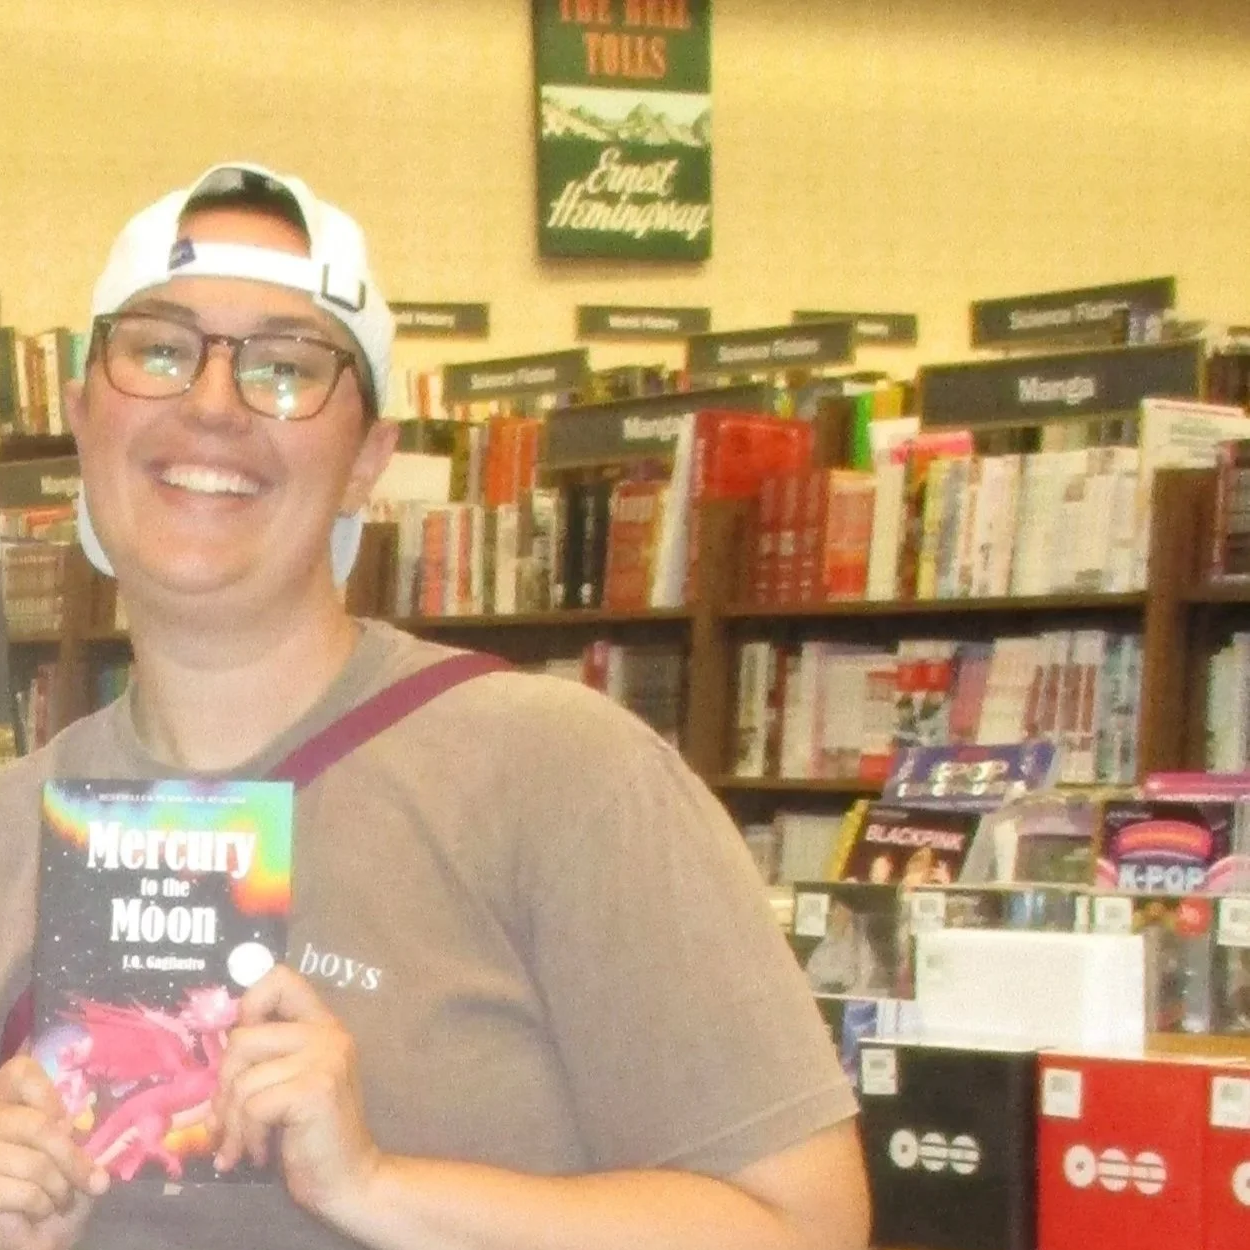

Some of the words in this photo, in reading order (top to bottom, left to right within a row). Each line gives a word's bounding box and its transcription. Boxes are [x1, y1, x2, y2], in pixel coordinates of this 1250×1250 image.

[583, 31, 667, 79] TOLLS
[584, 147, 679, 197] Ernest
[546, 180, 711, 241] Hemingway
[1018, 376, 1095, 405] Manga
[87, 821, 256, 879] Mercury
[865, 821, 965, 851] BLACKPINK
[140, 877, 157, 897] to
[163, 877, 190, 898] the
[1118, 863, 1206, 892] K-POP
[110, 898, 217, 945] Moon
[298, 943, 383, 991] boys
